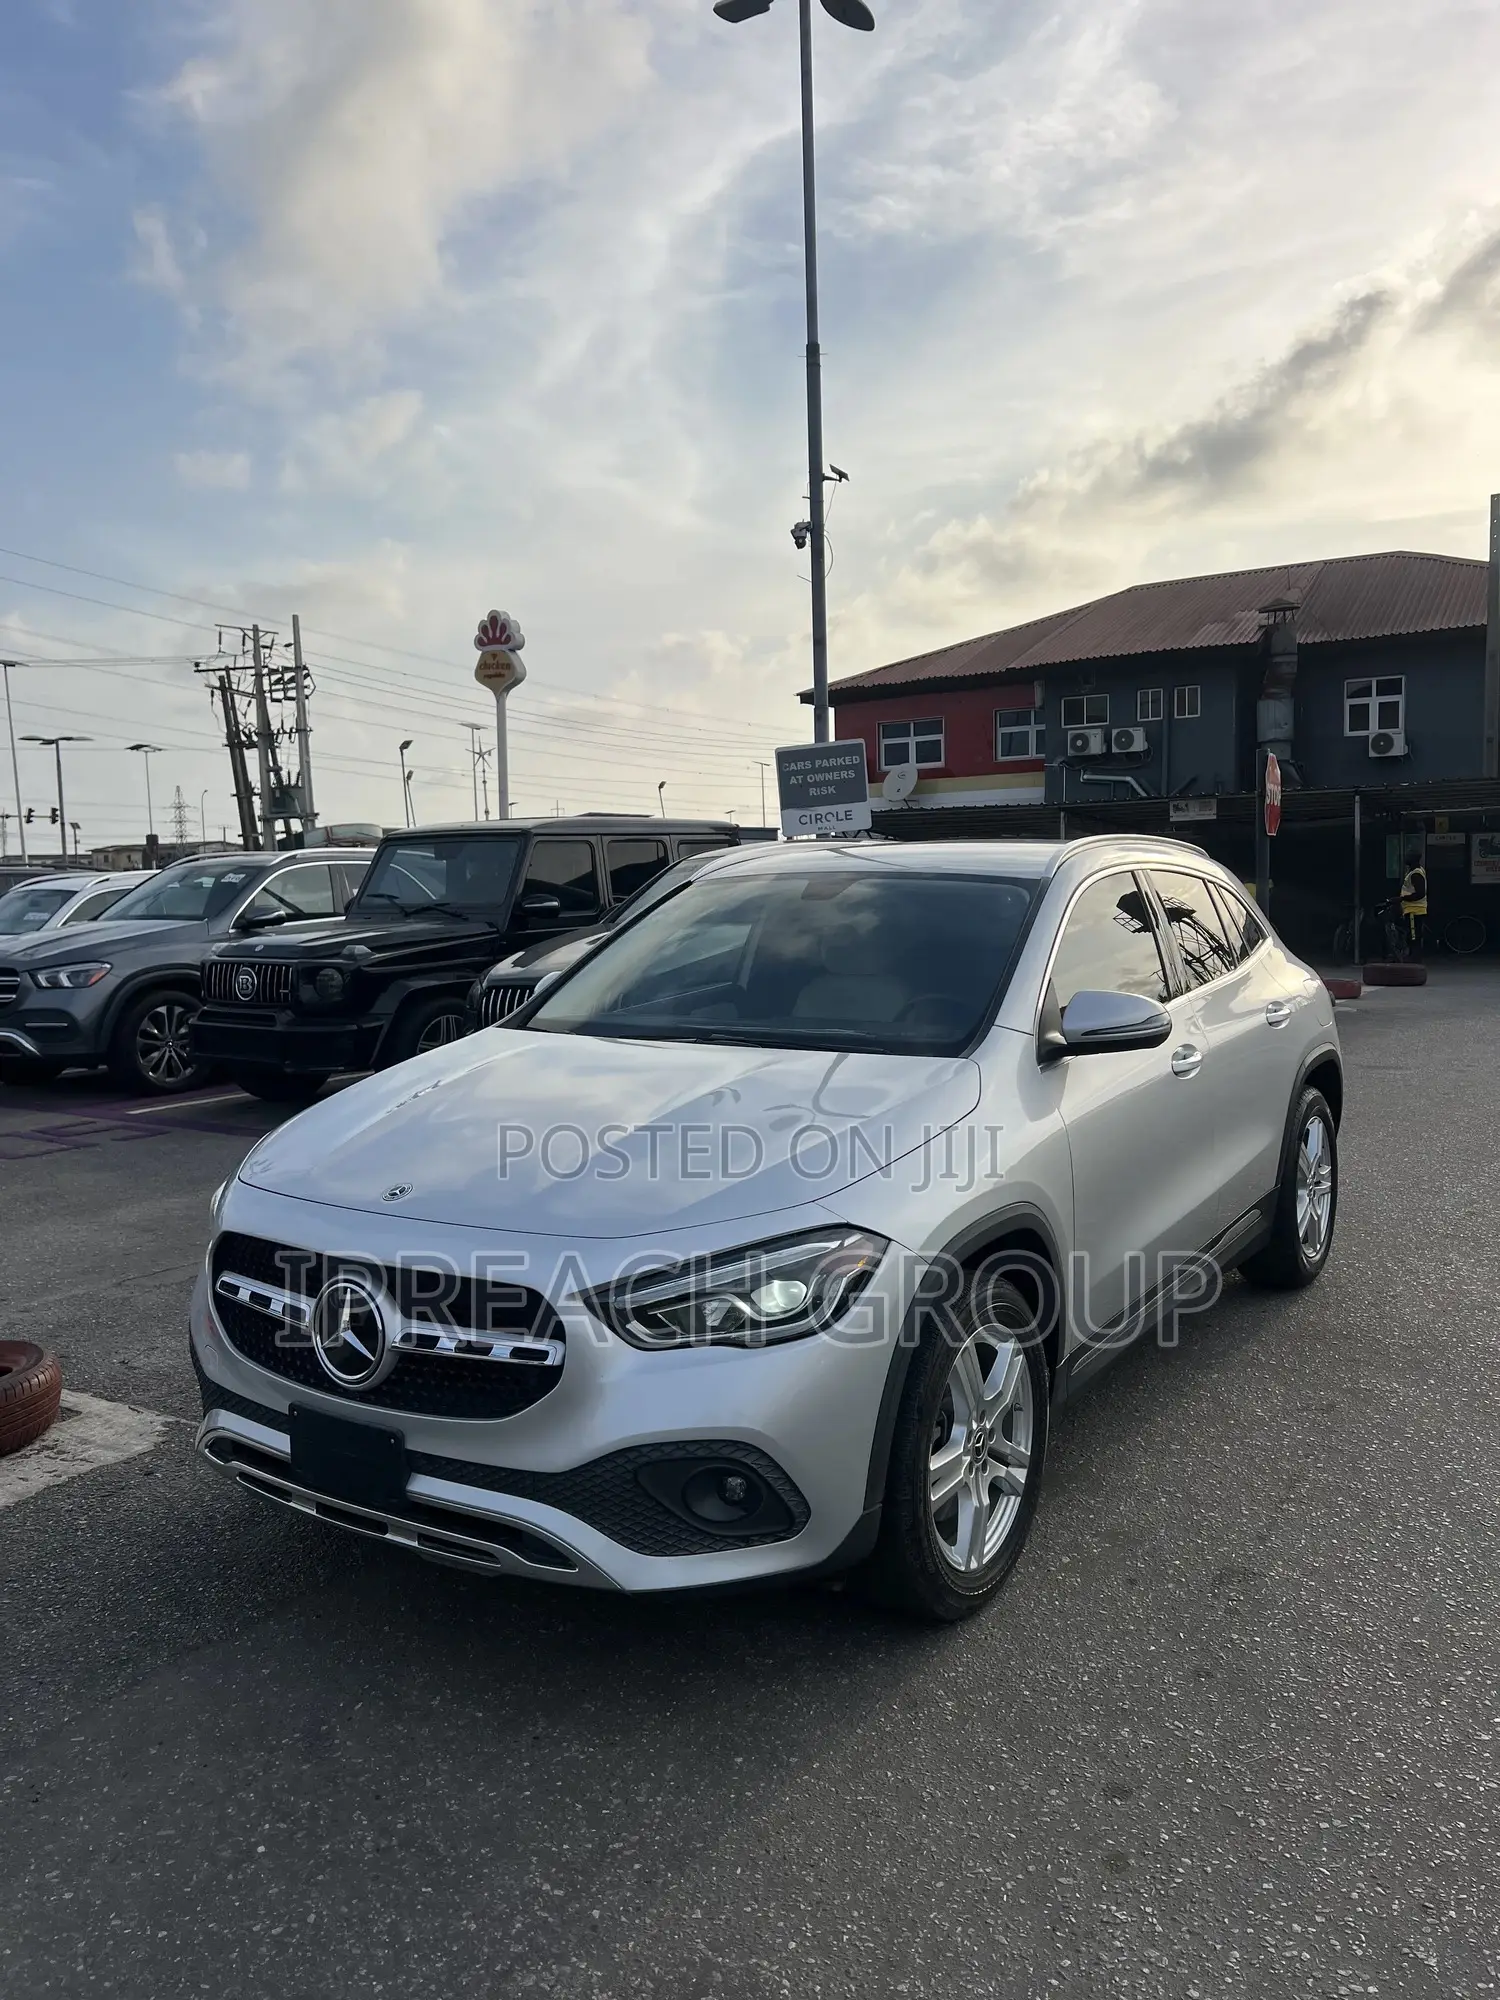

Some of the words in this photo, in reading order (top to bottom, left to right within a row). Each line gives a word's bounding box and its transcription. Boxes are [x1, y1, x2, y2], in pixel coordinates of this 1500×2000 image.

[782, 760, 812, 772] CARS
[815, 755, 861, 768] PARKED
[789, 775, 804, 785] AT
[806, 769, 856, 783] OWNERS
[808, 785, 837, 797] RISK
[1266, 783, 1282, 807] STOP
[798, 809, 854, 826] CIRCLE
[239, 975, 252, 994] B
